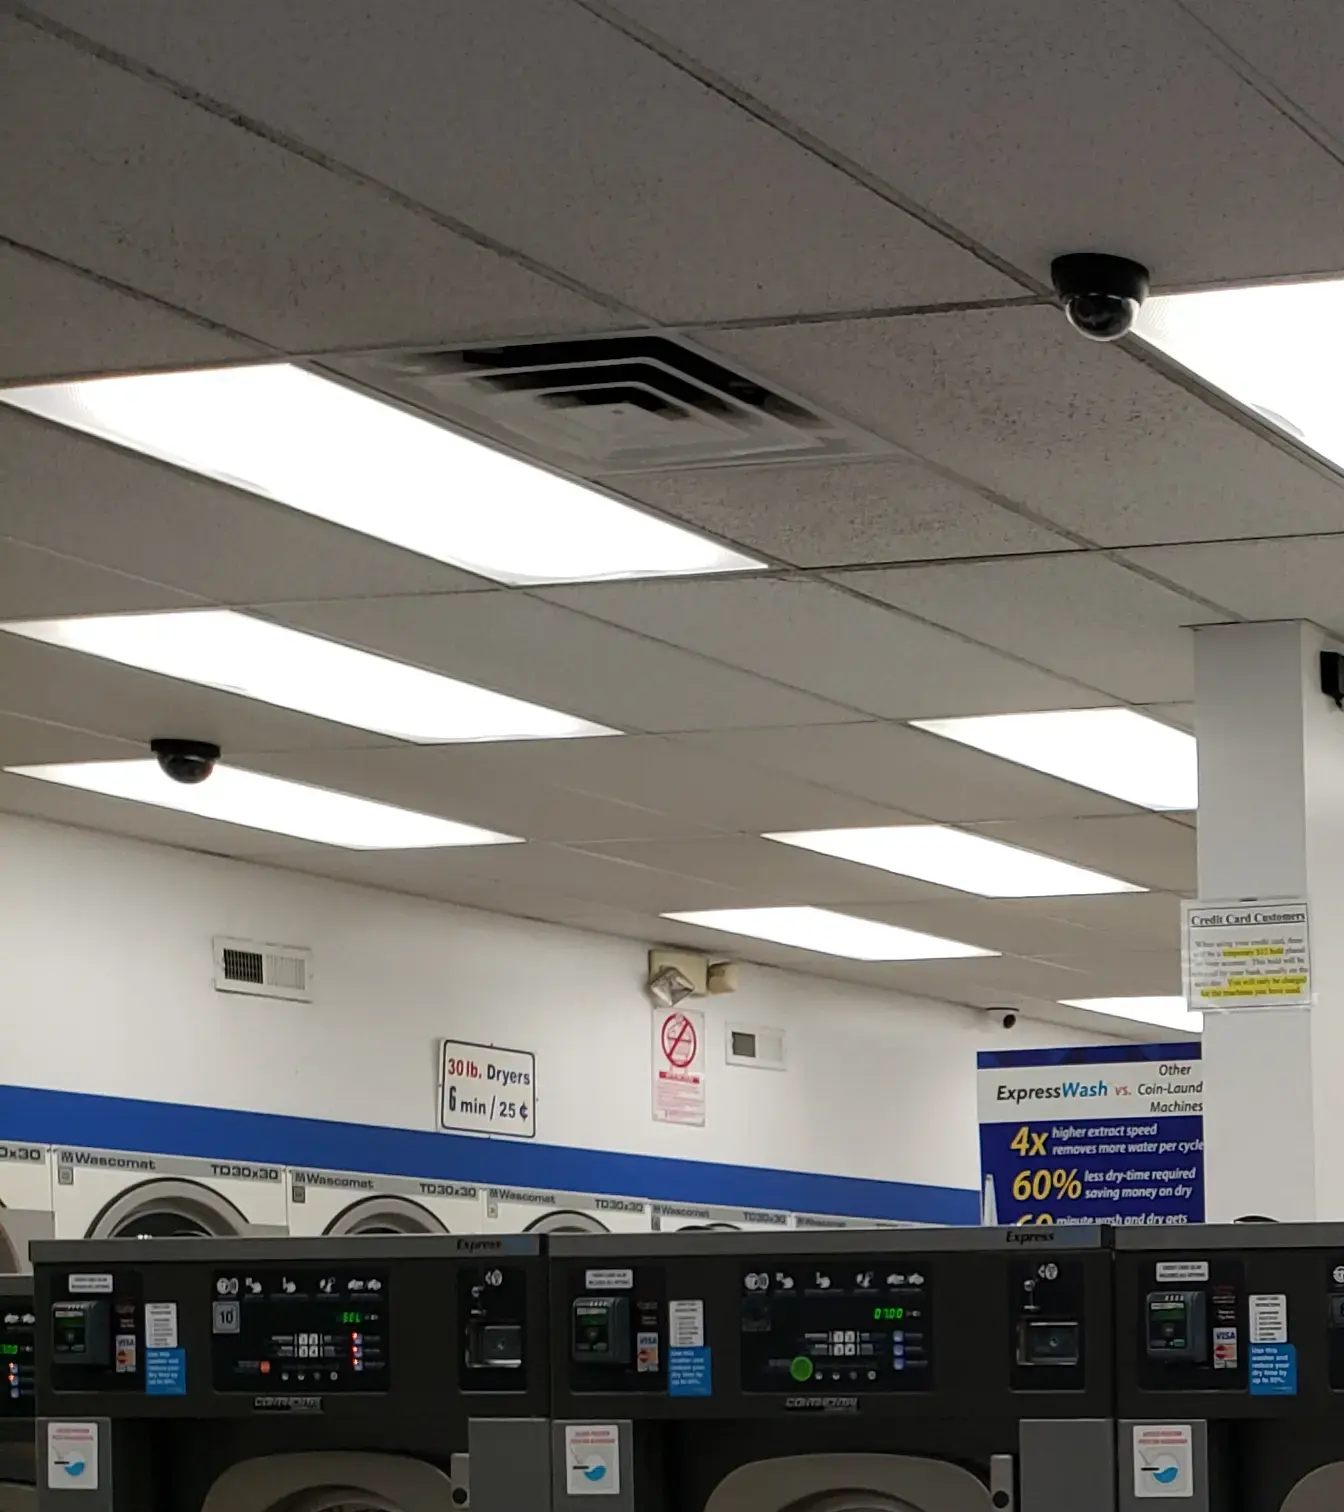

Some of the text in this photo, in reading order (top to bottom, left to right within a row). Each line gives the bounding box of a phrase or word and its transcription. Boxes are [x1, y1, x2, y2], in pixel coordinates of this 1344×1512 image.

[1191, 912, 1305, 926] Credit Card Customers
[487, 1064, 531, 1087] Dryers
[1159, 1063, 1191, 1076] Other
[997, 1080, 1203, 1103] ExpressWash vs. Coin-Laund
[449, 1086, 457, 1112] 6
[461, 1096, 487, 1116] min
[500, 1101, 516, 1119] 25
[1150, 1101, 1203, 1113] Machines
[1052, 1123, 1157, 1141] higher extract speed
[1011, 1126, 1048, 1156] 4x
[1052, 1144, 1097, 1155] removes
[1099, 1143, 1126, 1153] more
[1127, 1142, 1157, 1153] water
[1159, 1141, 1177, 1154] per
[75, 1154, 279, 1182] Wascomat TD30x30
[1085, 1167, 1196, 1184] less dry-time required
[307, 1172, 477, 1198] Wascomat TD30x30
[1012, 1168, 1082, 1201] 60%
[1085, 1184, 1192, 1201] saving money on dry
[500, 1189, 557, 1205] Wascomat
[1124, 1213, 1146, 1224] and
[219, 1310, 234, 1325] 10
[1215, 1331, 1236, 1340] VISA
